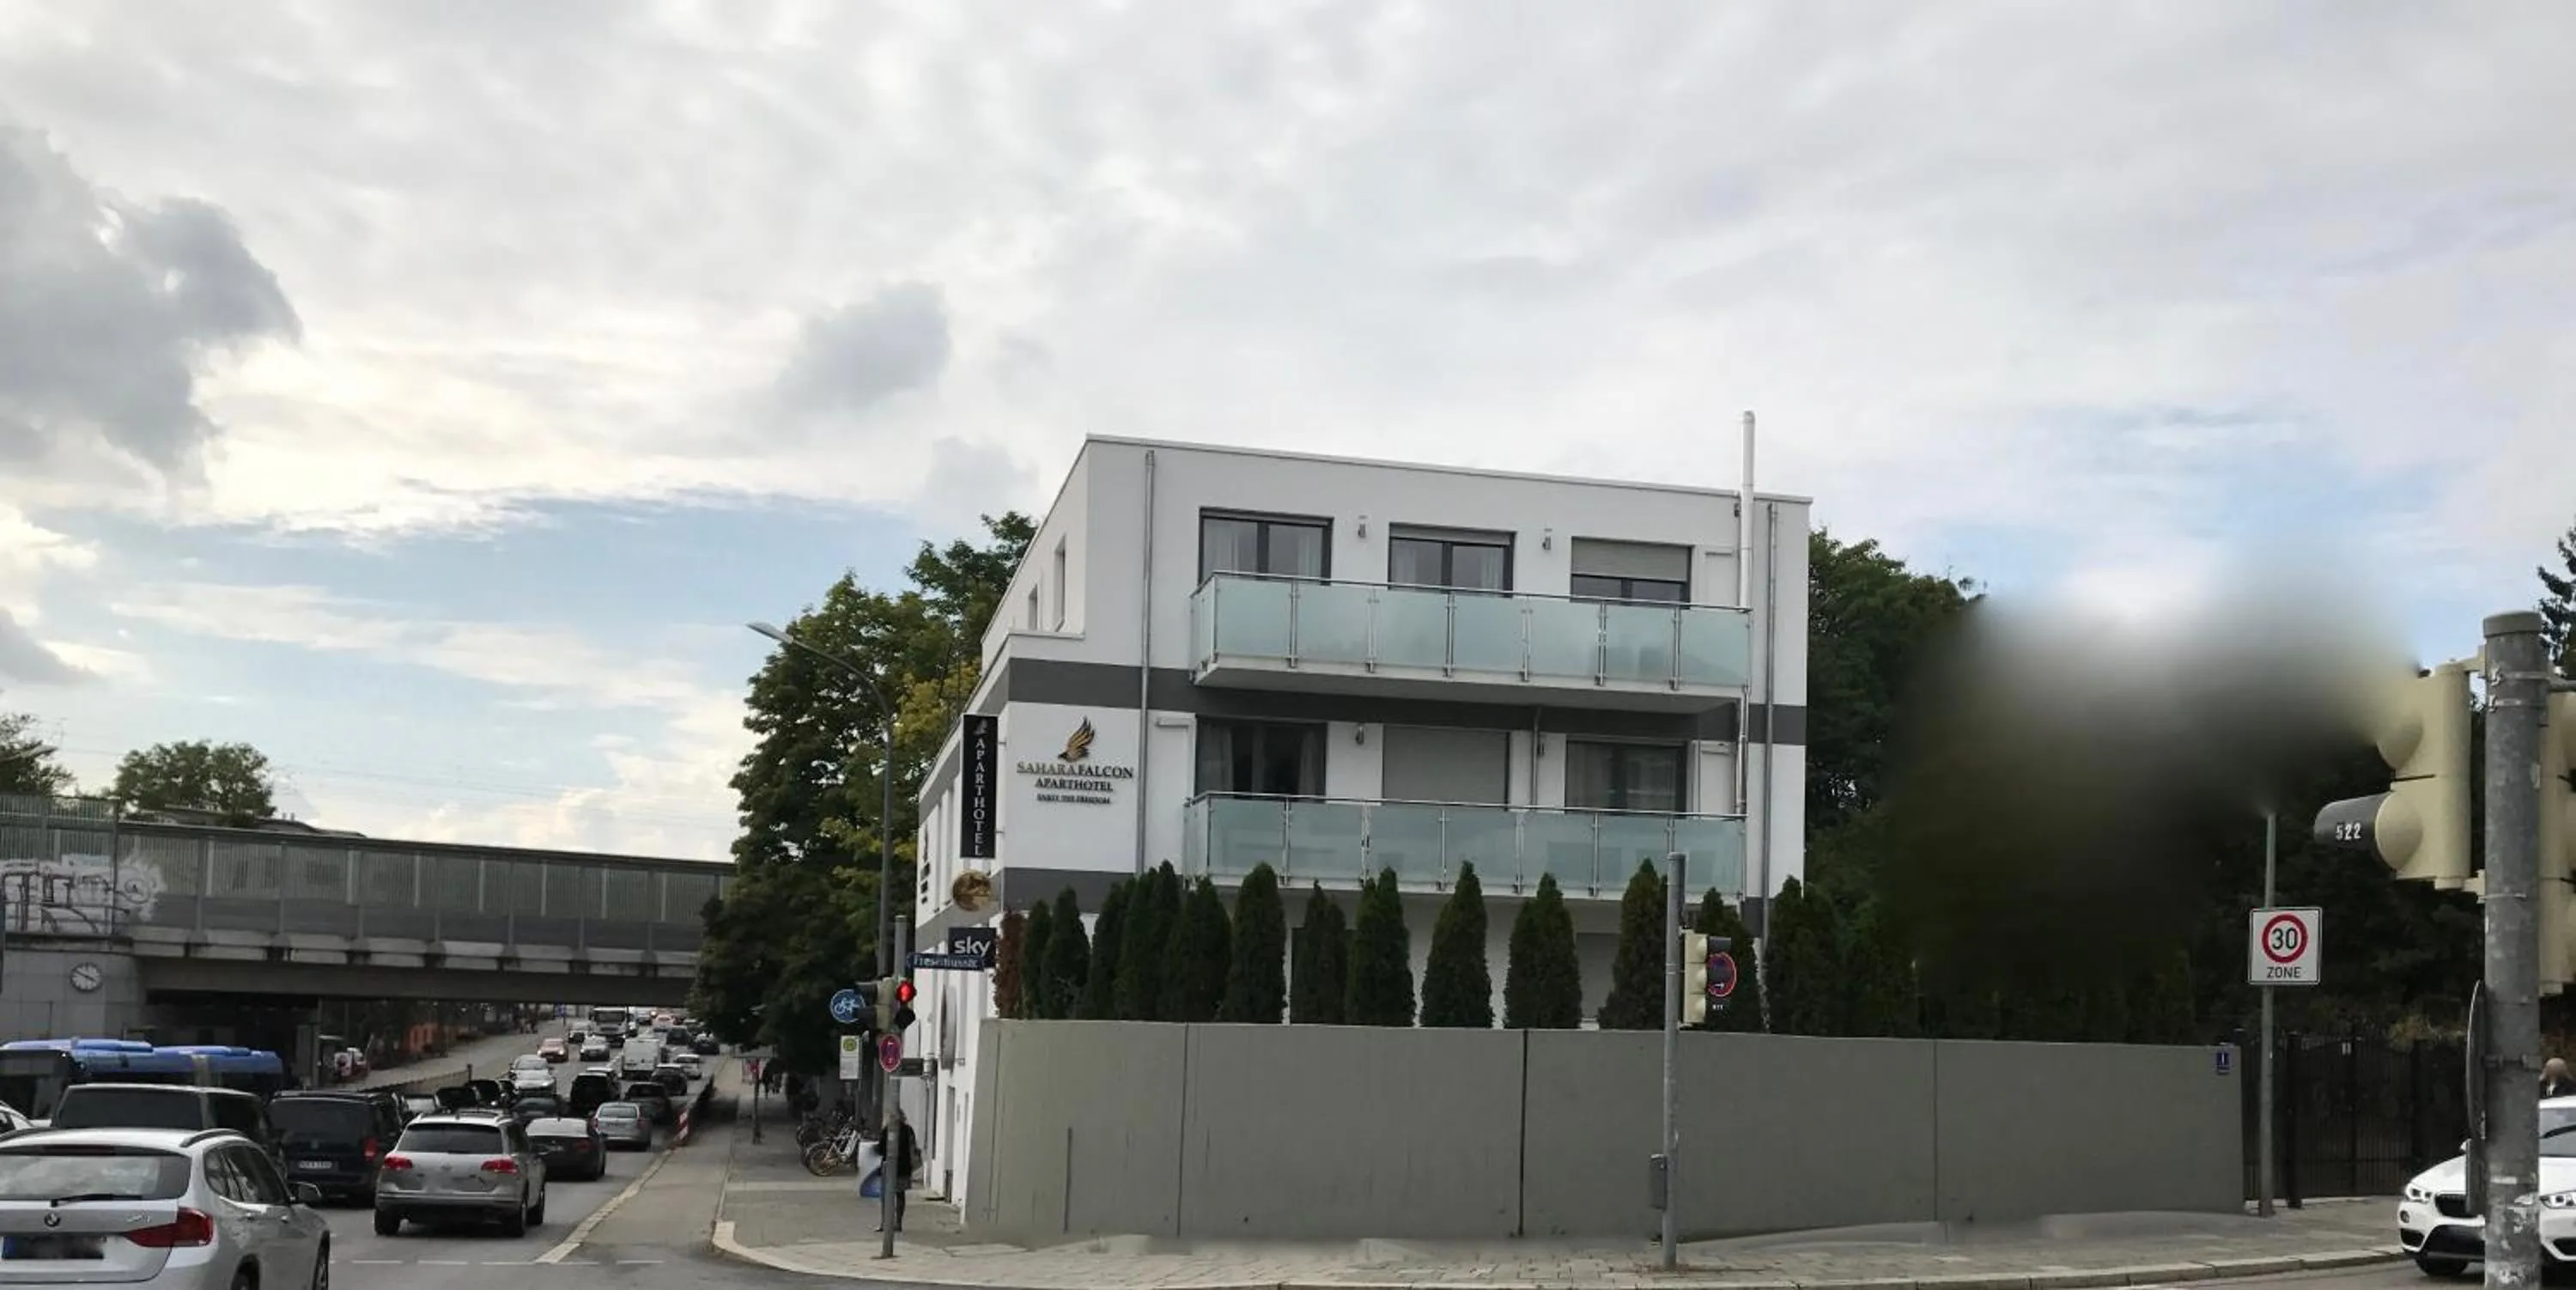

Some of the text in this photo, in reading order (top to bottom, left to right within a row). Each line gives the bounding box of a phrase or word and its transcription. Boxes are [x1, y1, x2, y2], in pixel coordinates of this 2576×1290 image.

[1035, 777, 1114, 792] APARTHOTEL
[973, 738, 985, 855] APARTHOTEL
[2336, 822, 2361, 841] 522
[954, 935, 991, 958] sky
[2271, 928, 2298, 950] 30
[2266, 966, 2302, 978] ZONE
